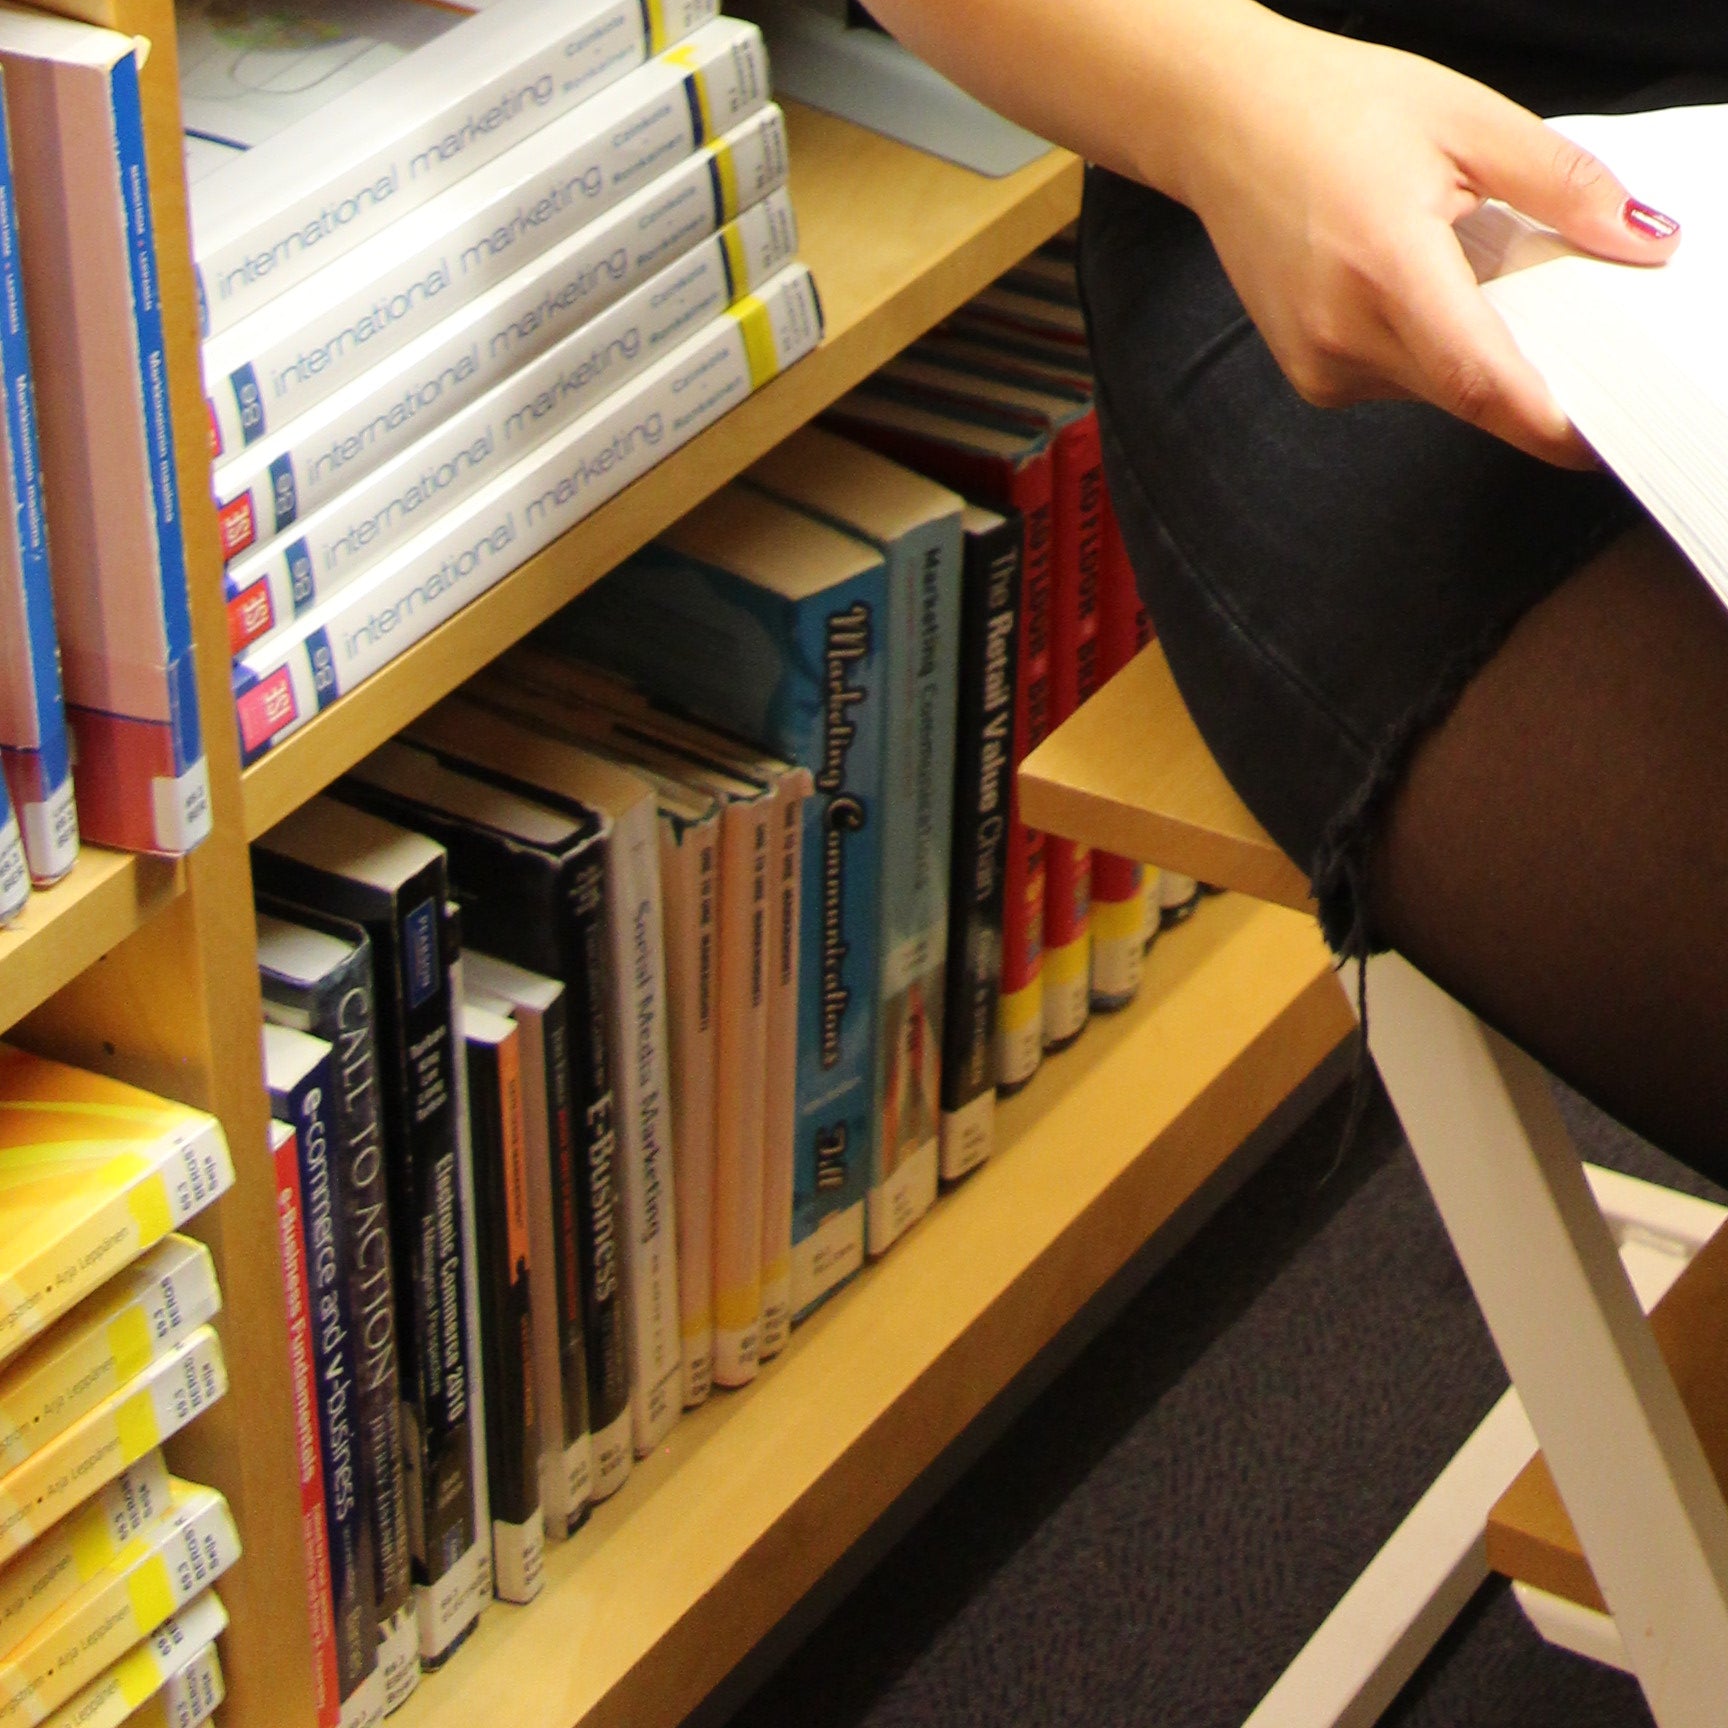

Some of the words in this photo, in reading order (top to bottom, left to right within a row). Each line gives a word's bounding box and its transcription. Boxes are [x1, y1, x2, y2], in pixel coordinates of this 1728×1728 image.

[219, 162, 400, 303] international
[409, 72, 556, 183] marketing
[271, 256, 454, 399] international
[461, 162, 605, 275] marketing
[305, 343, 482, 487] international
[488, 244, 630, 360] marketing
[323, 424, 494, 571] international
[503, 321, 643, 441] marketing
[343, 511, 516, 660] international
[523, 408, 667, 529] marketing
[987, 545, 1018, 609] The
[815, 600, 874, 793] Marketing
[984, 606, 1016, 712] Retail
[977, 713, 1009, 817] Value
[819, 794, 867, 1069] Communications
[974, 814, 1004, 904] Chain
[631, 899, 654, 996] Social
[338, 986, 375, 1112] CALL
[635, 996, 656, 1089] Media
[303, 1085, 339, 1290] e-commerce
[349, 1123, 382, 1190] TO
[638, 1089, 666, 1246] Marketing
[319, 1286, 348, 1356] and
[352, 1201, 395, 1393] ACTION
[290, 1314, 316, 1486] Fundamentals
[324, 1353, 357, 1522] v-business
[444, 1362, 467, 1423] 2010
